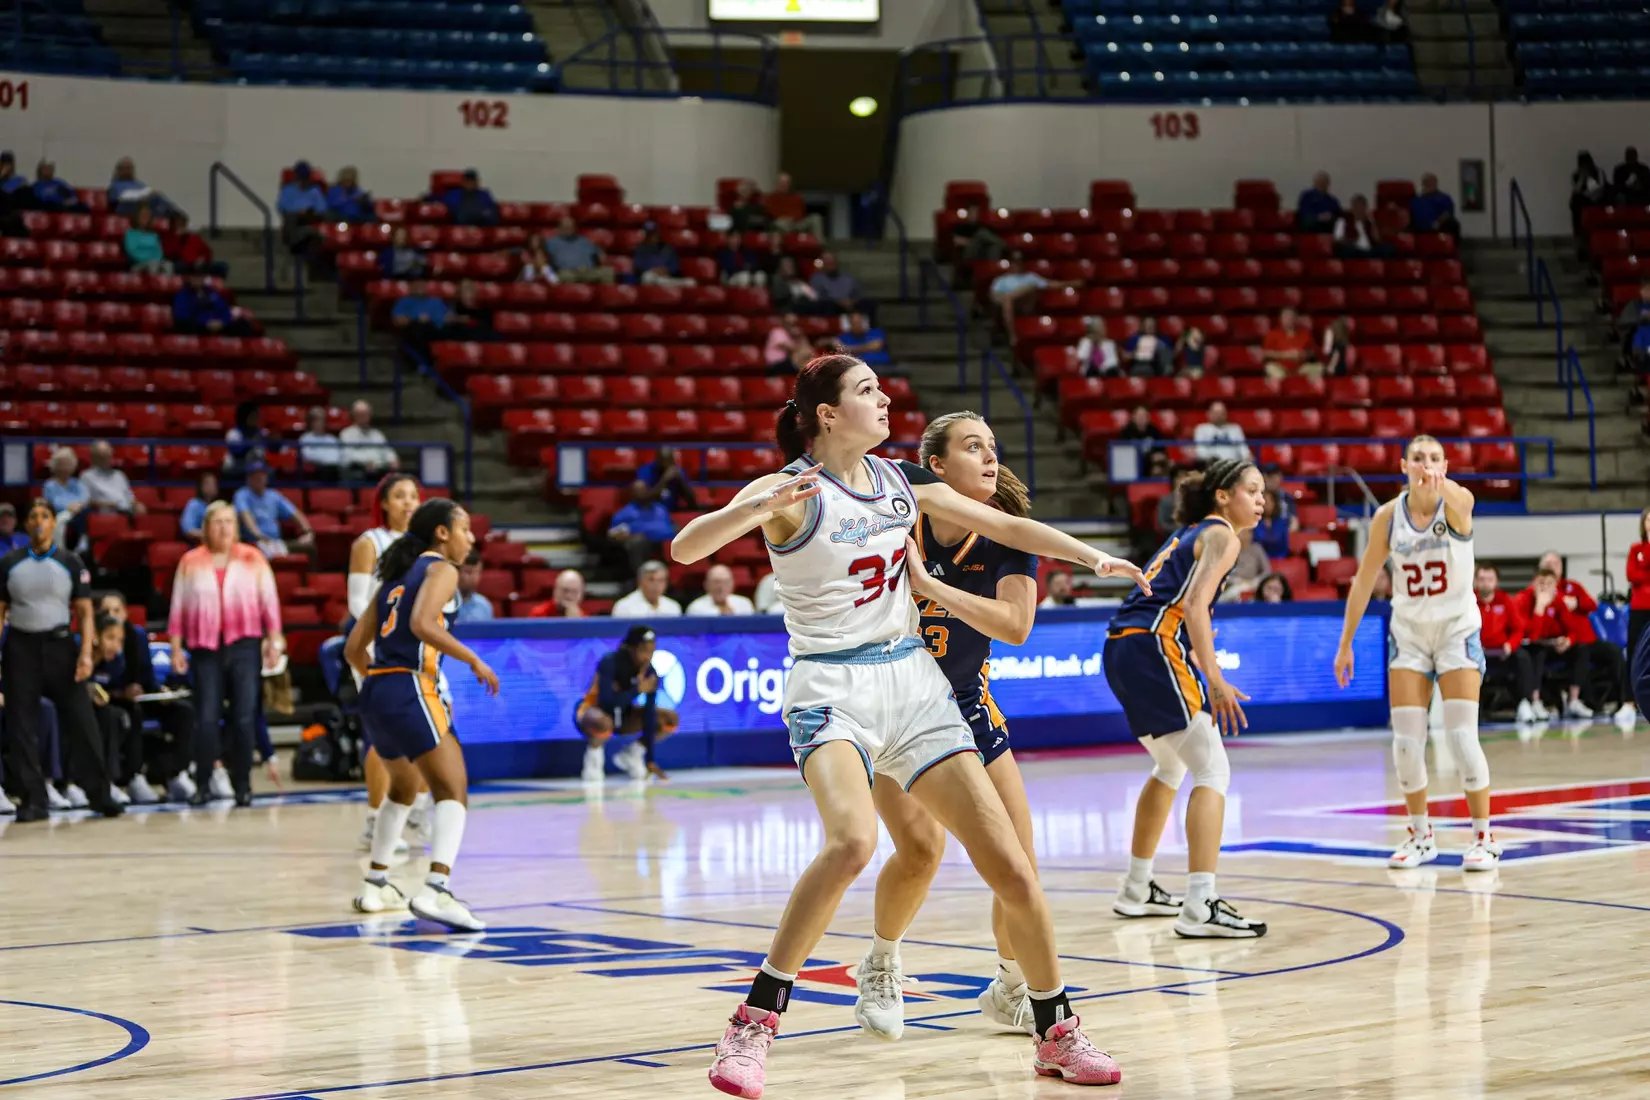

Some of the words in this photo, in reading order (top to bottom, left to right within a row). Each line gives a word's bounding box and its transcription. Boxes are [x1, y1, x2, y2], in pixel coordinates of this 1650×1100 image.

[458, 100, 509, 128] 102
[1150, 111, 1200, 139] 103
[830, 517, 868, 547] Lady
[1402, 561, 1448, 598] 23
[381, 585, 406, 638] 3
[917, 625, 950, 658] 3
[1043, 654, 1083, 678] Bank
